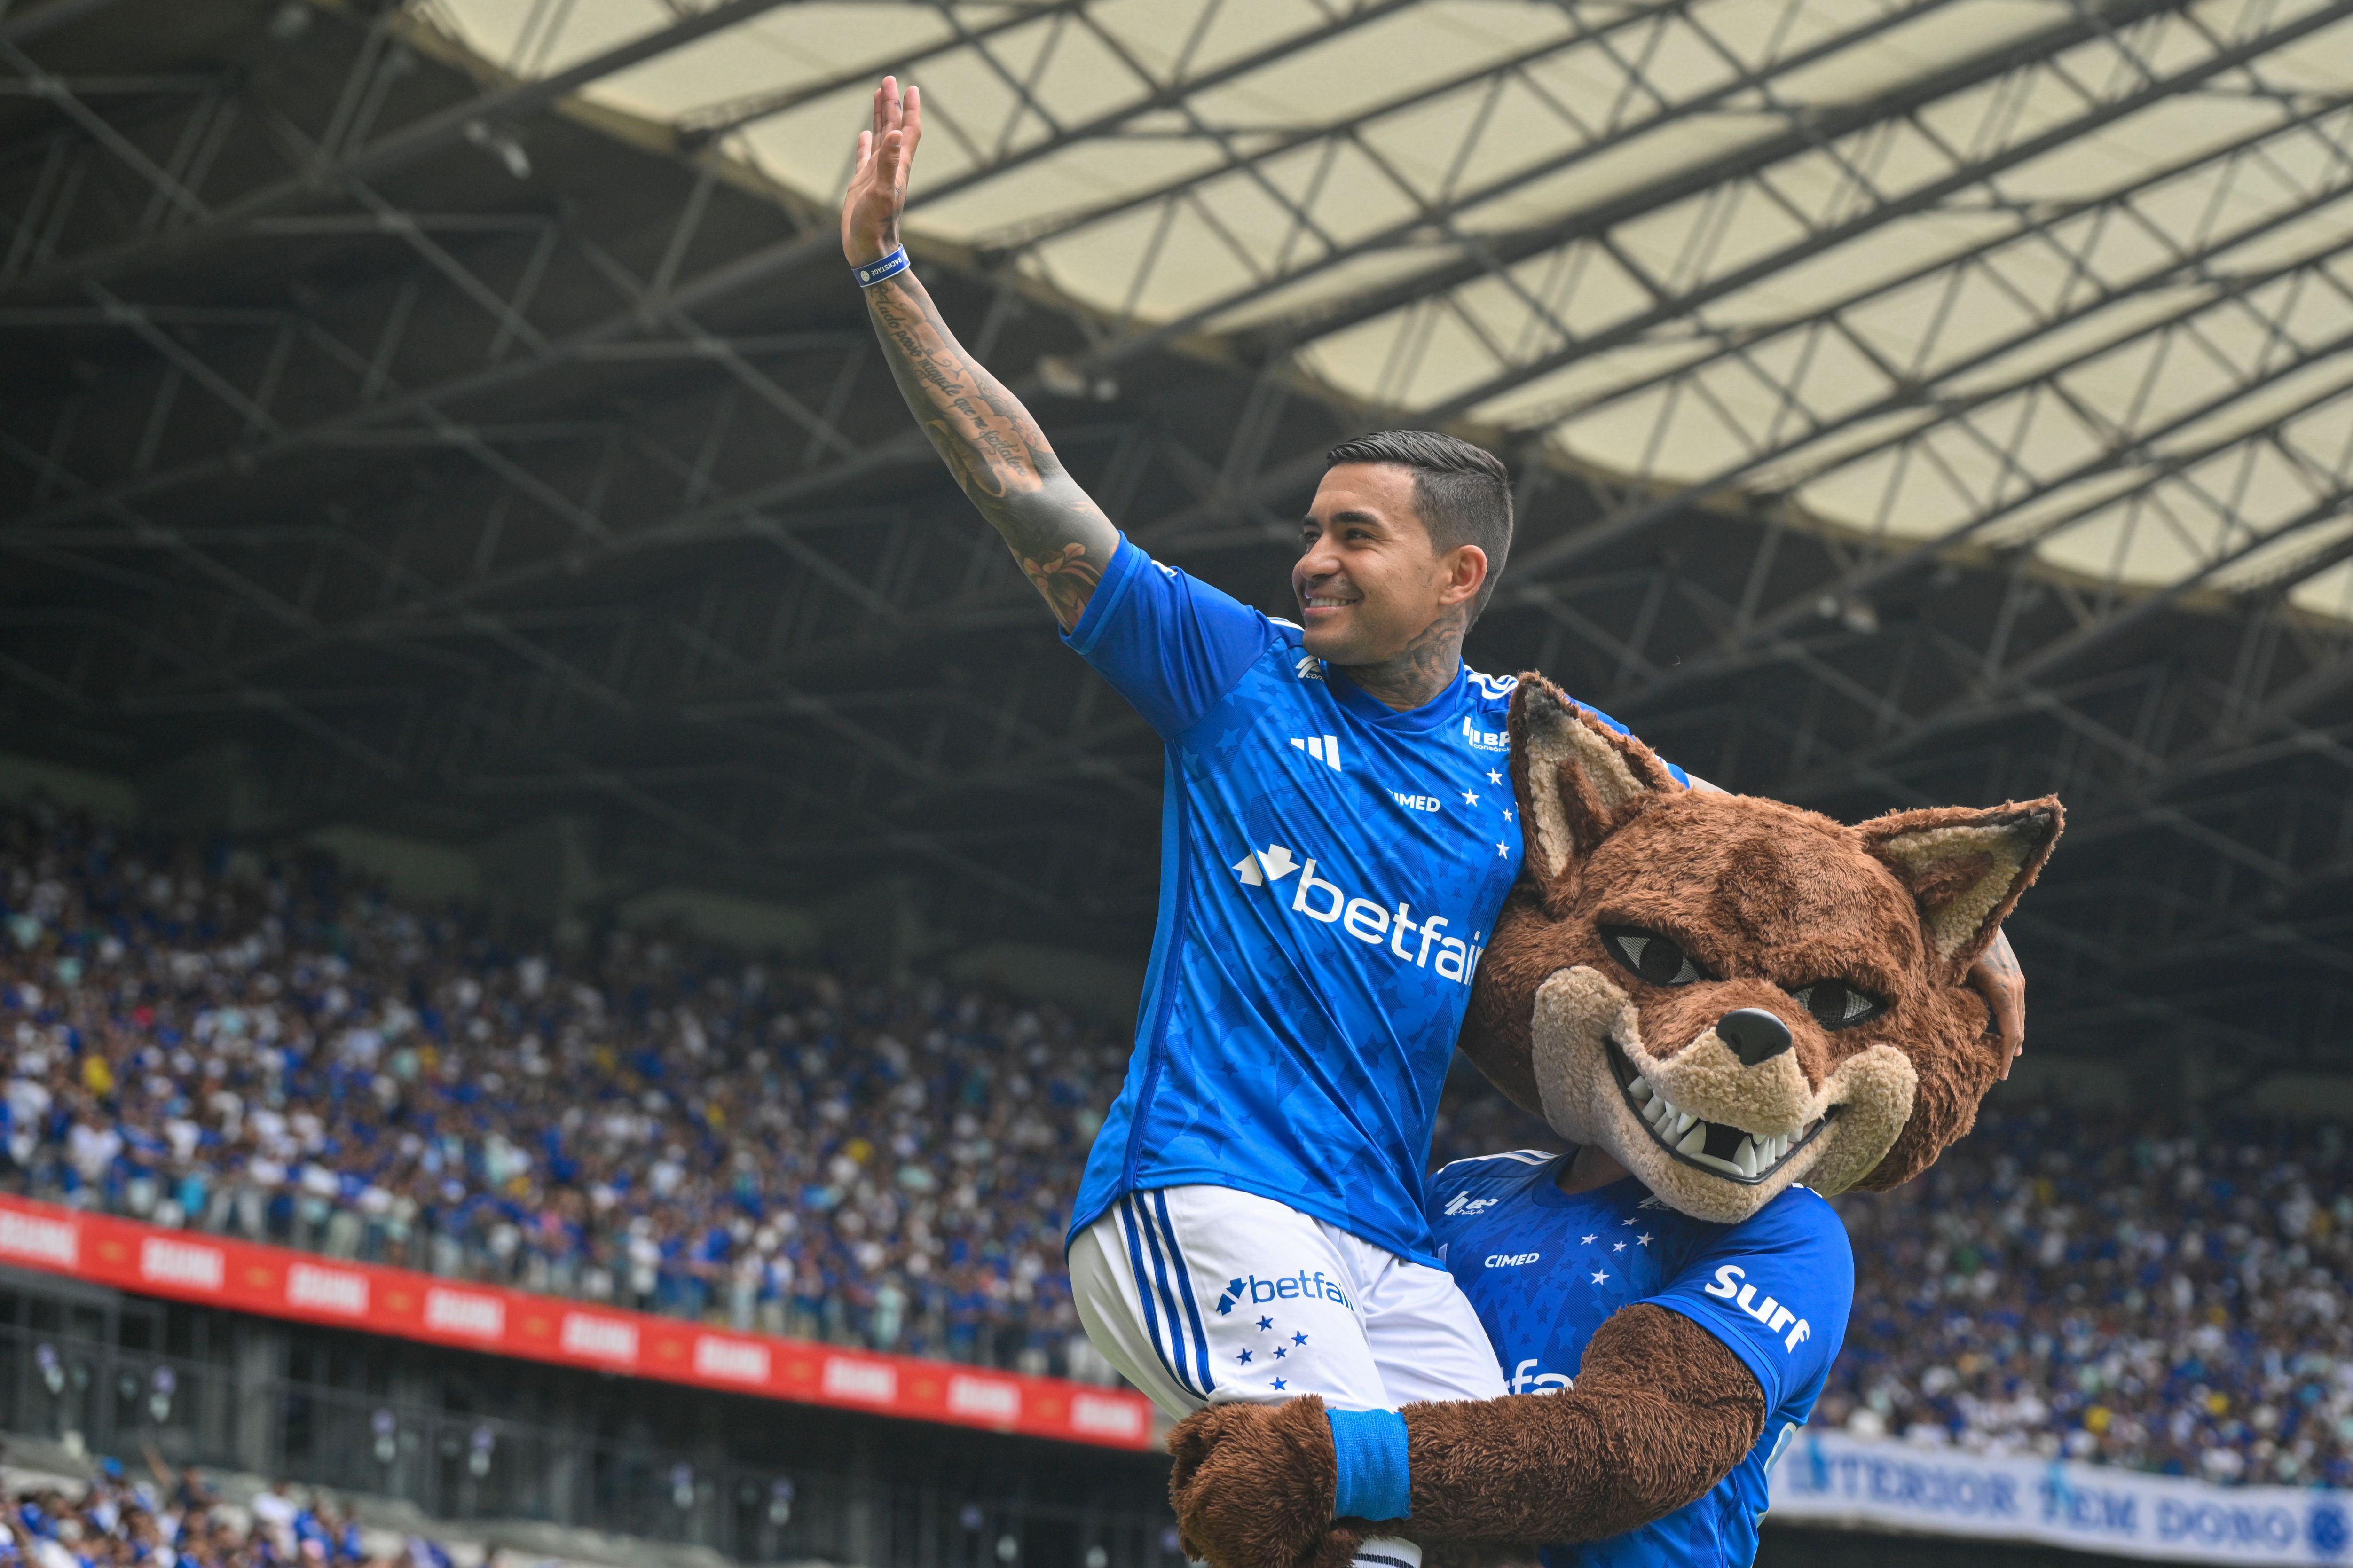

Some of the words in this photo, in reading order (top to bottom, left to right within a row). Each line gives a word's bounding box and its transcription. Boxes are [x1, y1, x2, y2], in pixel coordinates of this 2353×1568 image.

[871, 257, 902, 276] BACKSTAGE
[890, 329, 922, 358] posso
[947, 397, 976, 416] que
[971, 430, 1029, 477] fortalece
[1473, 743, 1511, 752] consórci
[1386, 788, 1440, 812] IMED
[1485, 1253, 1540, 1268] CIMED
[1705, 1265, 1810, 1354] Surf
